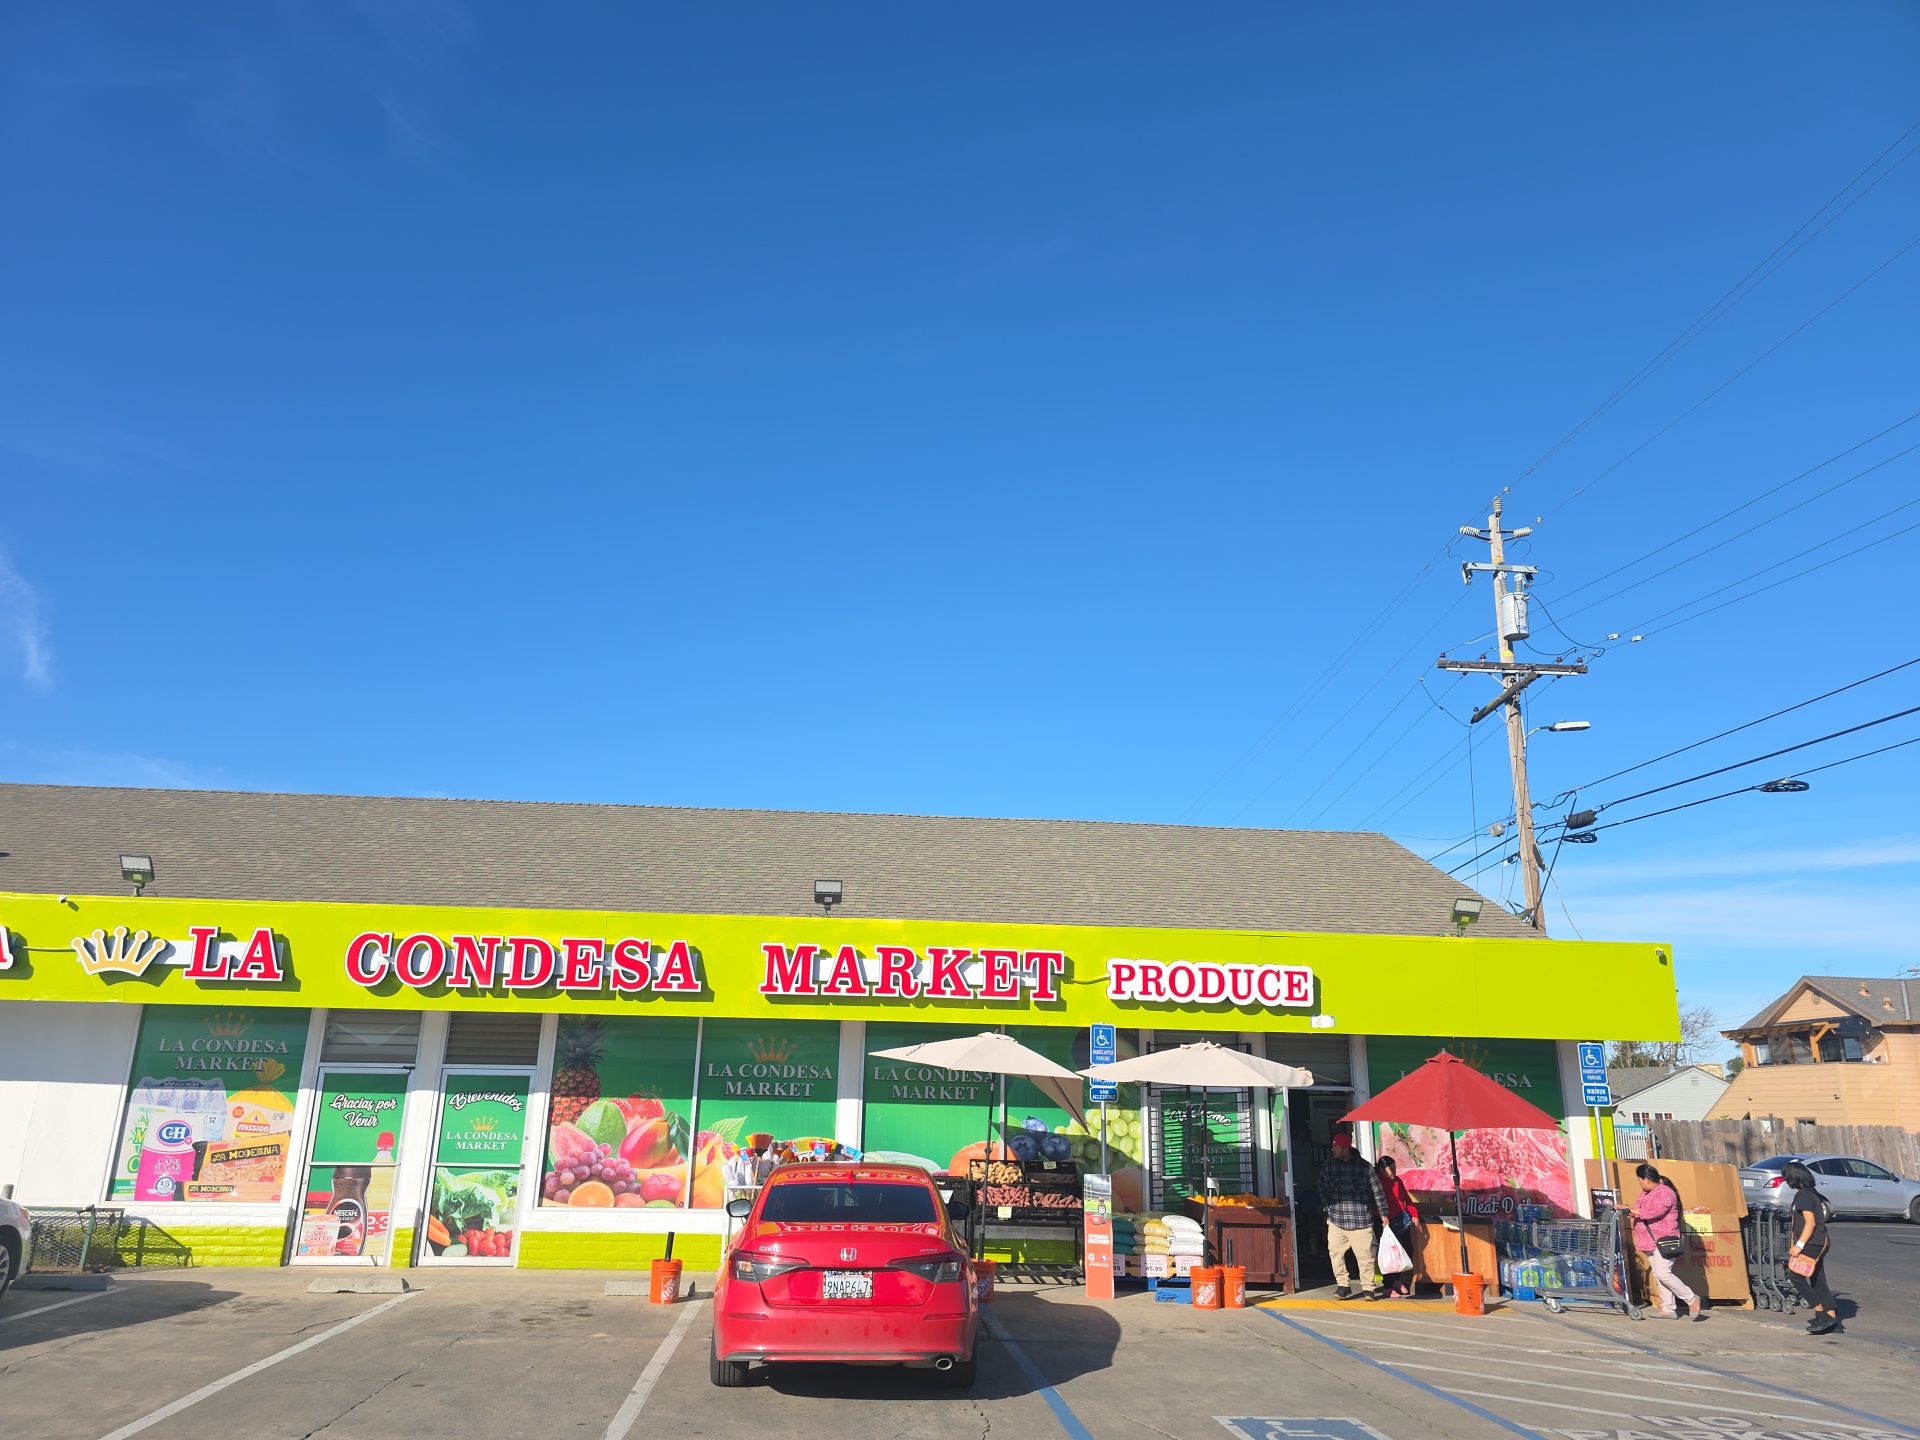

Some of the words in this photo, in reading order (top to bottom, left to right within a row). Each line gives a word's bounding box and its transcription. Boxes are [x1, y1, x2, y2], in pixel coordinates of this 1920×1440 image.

[182, 926, 284, 981] LA
[345, 930, 702, 993] CONDESA
[759, 942, 1065, 1002] MARKET
[1108, 959, 1313, 1006] PRODUCE
[158, 1038, 185, 1052] LA
[191, 1039, 289, 1054] CONDESA
[173, 1056, 268, 1071] MARKET
[707, 1063, 734, 1077] LA
[738, 1064, 833, 1079] CONDESA
[873, 1066, 899, 1080] LA
[904, 1067, 996, 1083] CONDESA
[724, 1081, 814, 1097] MARKET
[891, 1084, 979, 1100] MARKET
[330, 1093, 375, 1111] Gracias
[374, 1097, 398, 1113] por
[343, 1111, 379, 1127] Venir
[446, 1131, 461, 1140] LA
[464, 1132, 518, 1141] CONDESA
[456, 1141, 507, 1150] MARKET
[153, 1163, 182, 1171] SUGAR
[1465, 1195, 1500, 1214] Meat
[1691, 1254, 1733, 1268] POTATOES
[827, 1280, 869, 1294] 9NAP647
[1636, 1415, 1752, 1427] NO
